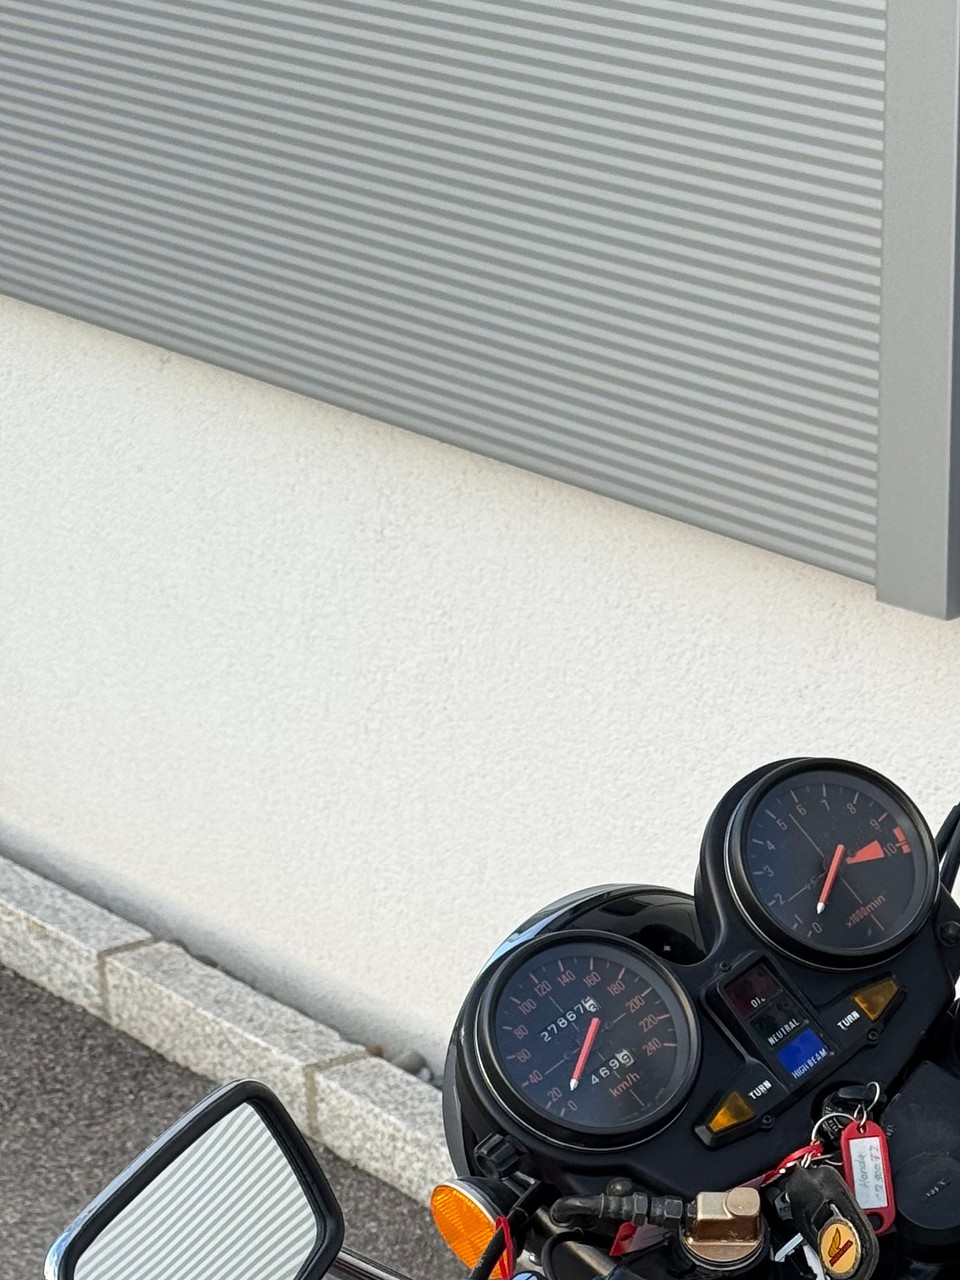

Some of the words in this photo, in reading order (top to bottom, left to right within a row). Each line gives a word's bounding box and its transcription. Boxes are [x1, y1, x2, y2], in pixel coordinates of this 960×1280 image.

[796, 803, 807, 816] 6
[821, 799, 830, 811] 7
[846, 802, 857, 815] 8
[776, 818, 787, 831] 5
[766, 840, 776, 851] 4
[774, 892, 785, 905] 2
[557, 969, 576, 987] 140
[583, 971, 601, 988] 160
[534, 980, 552, 998] 120
[606, 979, 626, 997] 180
[518, 997, 537, 1015] 100
[625, 994, 646, 1014] 200
[638, 1014, 658, 1032] 220
[836, 1010, 861, 1031] TURN
[513, 1024, 529, 1040] 80
[767, 1018, 801, 1046] NEUTRAL
[516, 1047, 532, 1063] 60
[642, 1037, 662, 1056] 240
[791, 1062, 810, 1080] HIGH
[807, 1047, 829, 1068] BEAM
[528, 1070, 543, 1085] 40
[609, 1071, 641, 1098] km/h
[547, 1087, 563, 1103] 20
[748, 1079, 773, 1100] TURN
